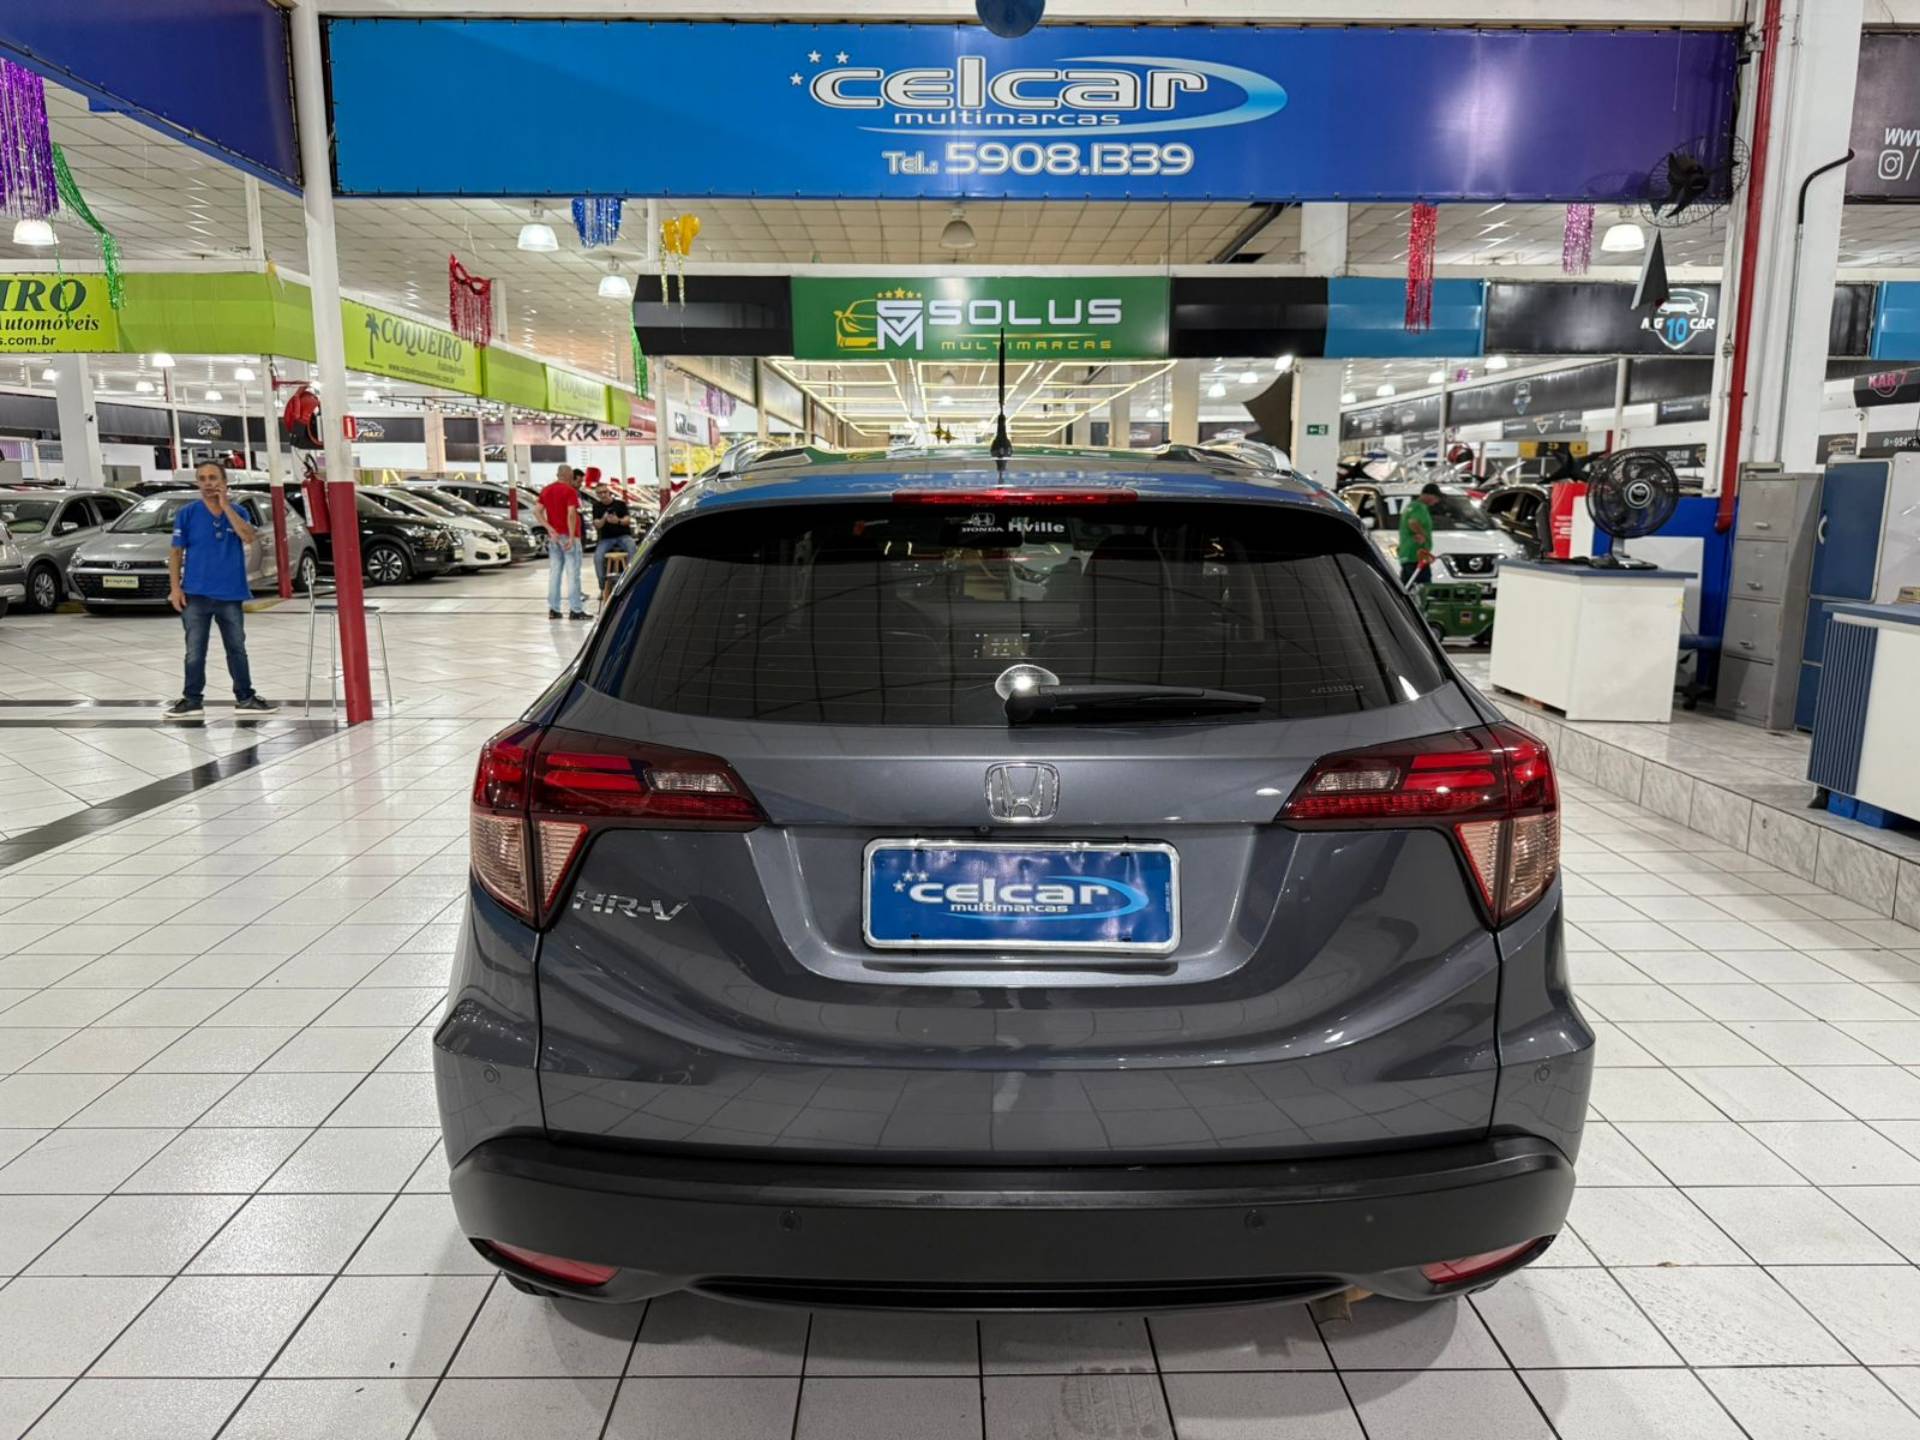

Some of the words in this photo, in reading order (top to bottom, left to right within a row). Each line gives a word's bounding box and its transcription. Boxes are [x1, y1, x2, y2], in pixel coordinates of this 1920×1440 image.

[810, 56, 1208, 110] celcar
[895, 111, 1121, 125] multimarcas
[1884, 128, 1920, 147] WW
[882, 151, 938, 174] Tel.:
[945, 142, 1195, 175] 5908.1339
[928, 299, 1122, 325] SOLUS
[1689, 318, 1716, 329] CAR
[381, 317, 462, 362] COQUEIRO
[941, 340, 1112, 350] MULTIMARCAS
[909, 878, 1110, 905] celcar
[572, 890, 689, 921] HR-V
[950, 902, 1069, 913] multimarcas
